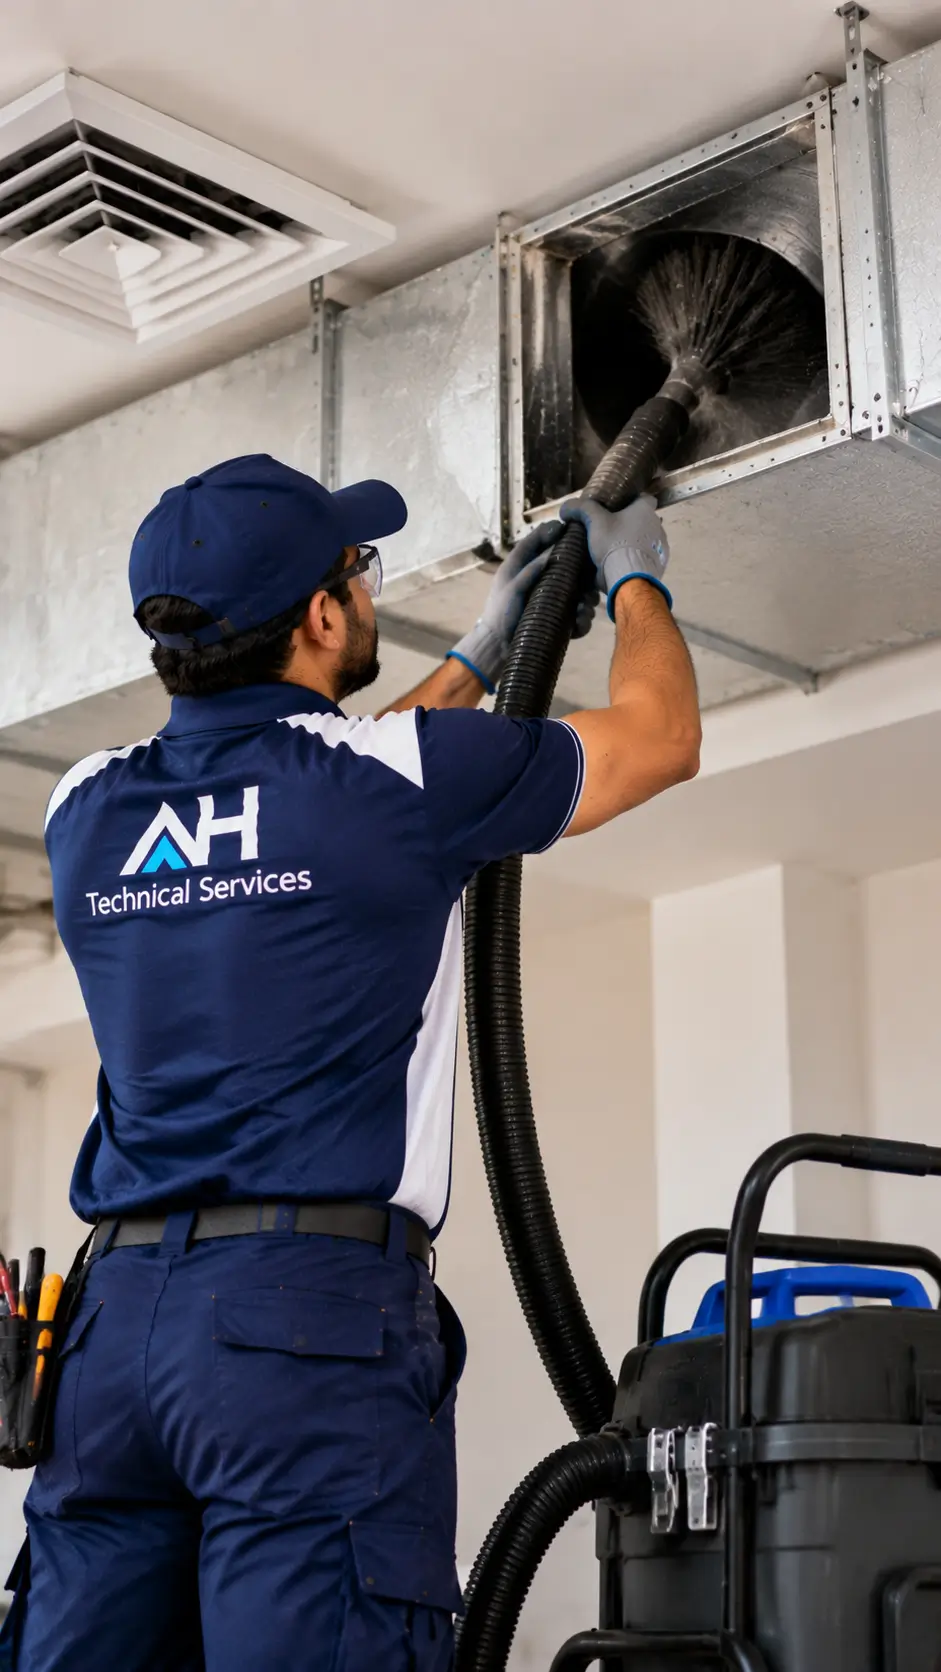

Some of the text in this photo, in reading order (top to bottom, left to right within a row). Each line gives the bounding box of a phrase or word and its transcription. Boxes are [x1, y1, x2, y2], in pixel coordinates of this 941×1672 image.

[119, 785, 259, 876] AH
[86, 869, 312, 916] Technical Services
